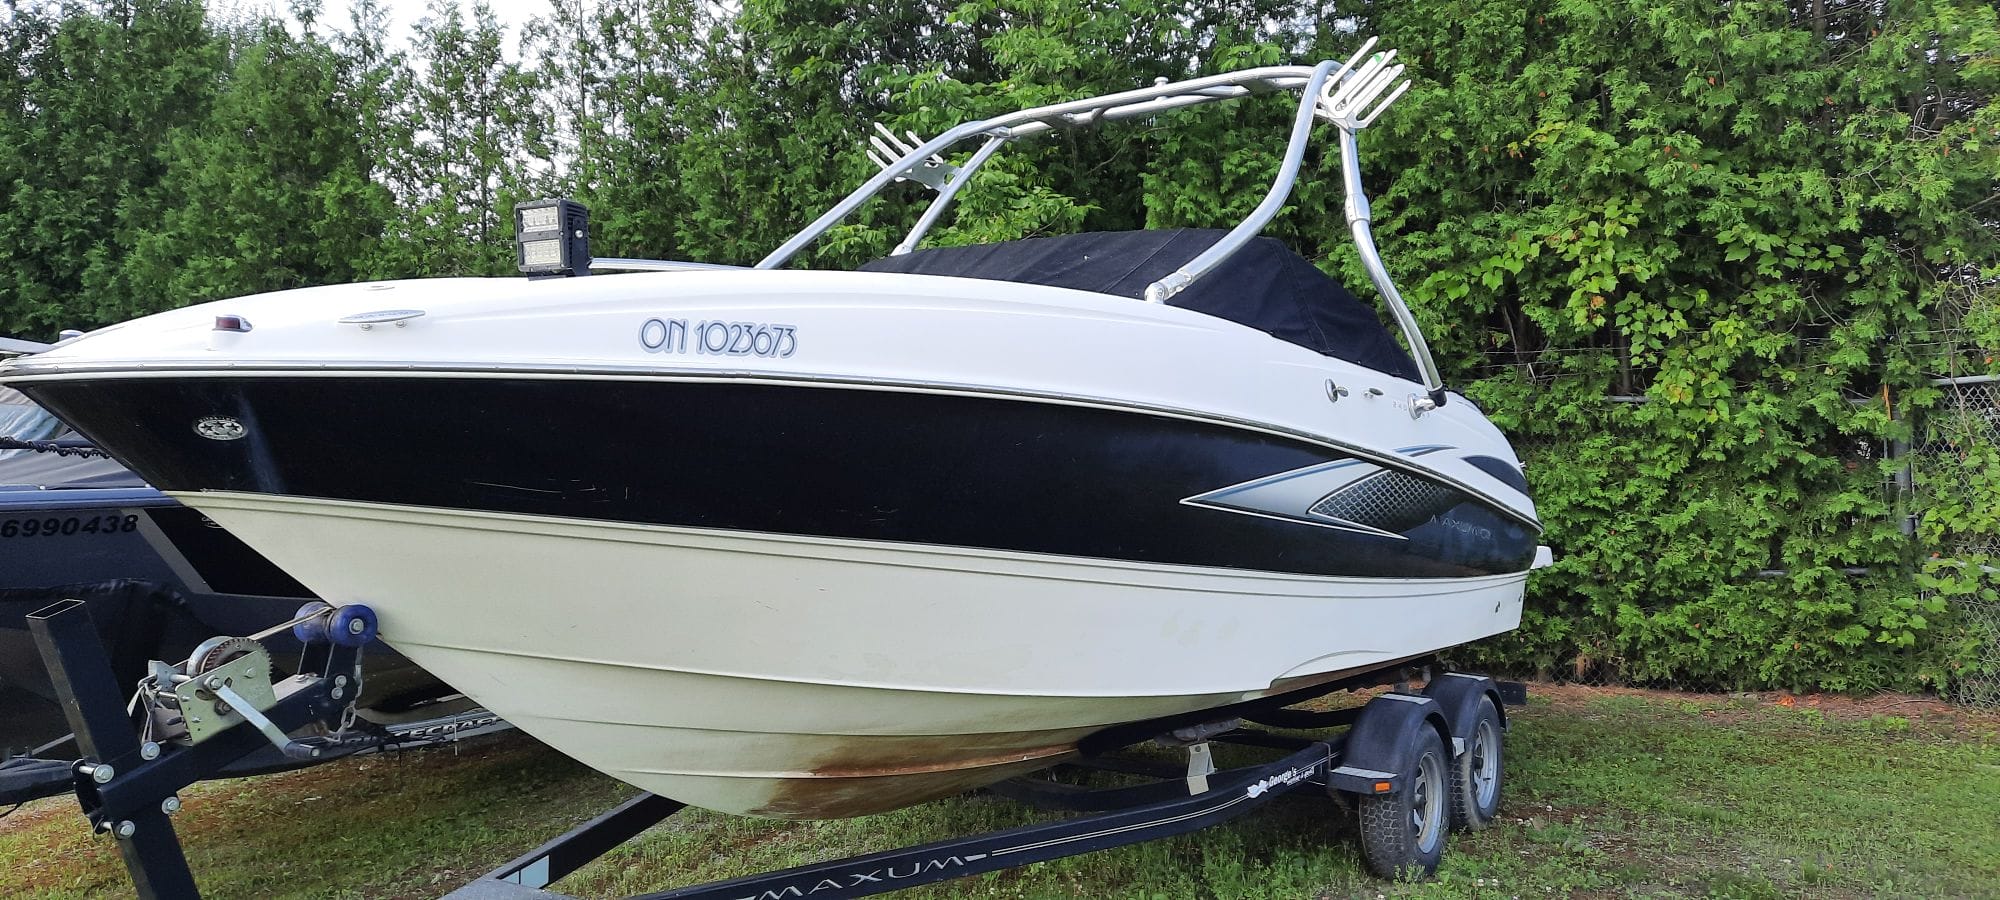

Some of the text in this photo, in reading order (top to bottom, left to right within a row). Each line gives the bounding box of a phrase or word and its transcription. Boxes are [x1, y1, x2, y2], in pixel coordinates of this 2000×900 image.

[640, 318, 797, 357] ON 1023673
[1, 514, 139, 538] 6990438
[758, 855, 965, 900] MAXUM
